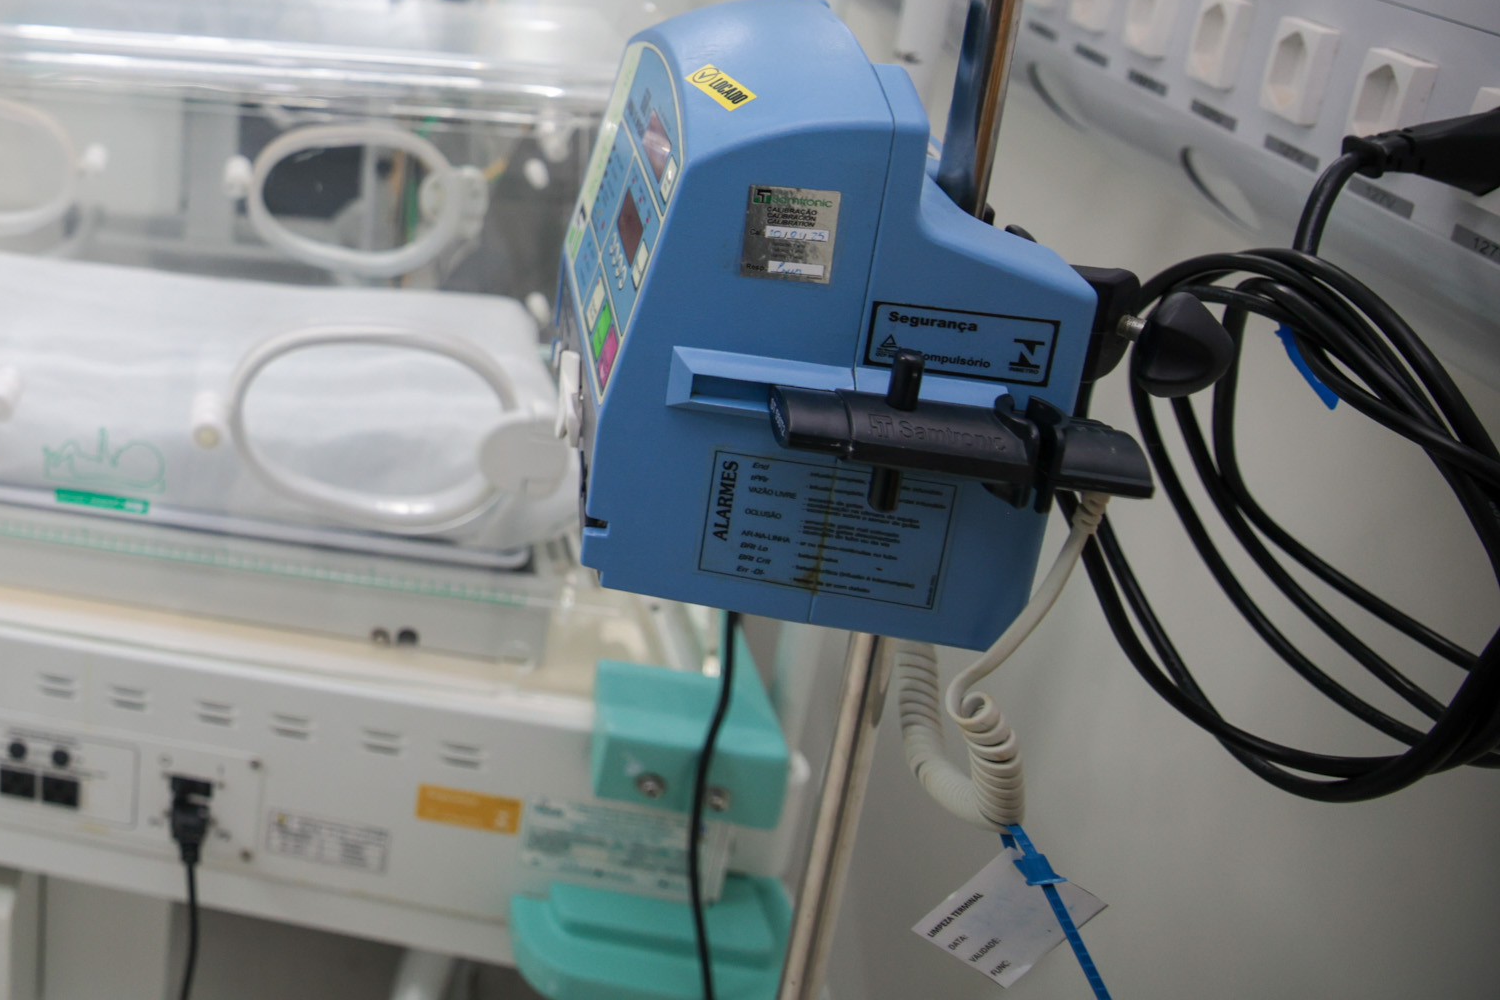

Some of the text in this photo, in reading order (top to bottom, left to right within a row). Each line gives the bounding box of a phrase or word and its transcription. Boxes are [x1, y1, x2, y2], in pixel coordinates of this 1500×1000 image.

[709, 77, 748, 104] LOCADO
[766, 206, 818, 216] CALIBRAÇÃO
[772, 193, 834, 209] Samtronic
[766, 219, 815, 228] CALIBRATION
[1473, 236, 1500, 258] 127
[889, 306, 978, 333] Segurança
[899, 420, 1005, 451] Samtronic
[712, 460, 739, 541] ALARMES
[927, 893, 984, 938] LIMPEZA TERMINAL
[948, 935, 969, 950] DATA:
[969, 938, 1002, 962] VALIDADE:
